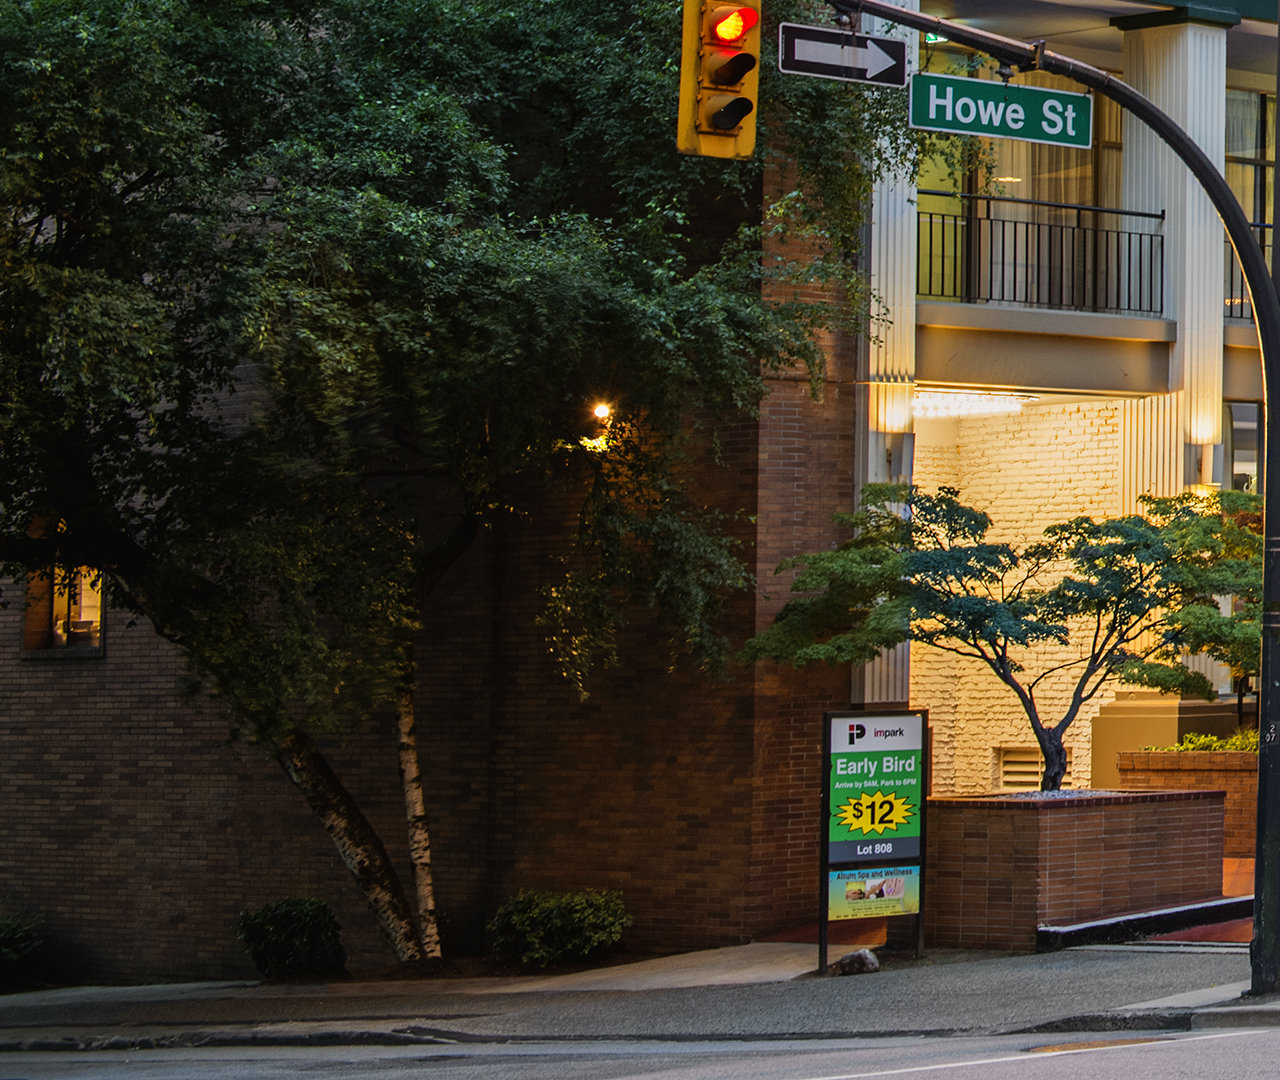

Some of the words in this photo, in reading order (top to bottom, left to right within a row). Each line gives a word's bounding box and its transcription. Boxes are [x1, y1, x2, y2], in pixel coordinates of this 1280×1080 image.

[928, 84, 1025, 130] Howe
[1041, 99, 1076, 137] St
[874, 728, 904, 739] impark
[836, 757, 877, 778] Early
[883, 755, 915, 773] Bird
[835, 781, 853, 789] Arrive
[854, 781, 862, 789] by
[863, 780, 879, 788] 9AM,
[880, 779, 894, 787] Park
[902, 778, 917, 786] 6PM
[852, 800, 894, 825] $12
[857, 844, 873, 855] Lot
[874, 843, 893, 854] 808
[857, 870, 869, 879] Spa
[871, 869, 883, 878] and
[884, 867, 913, 877] Wellness
